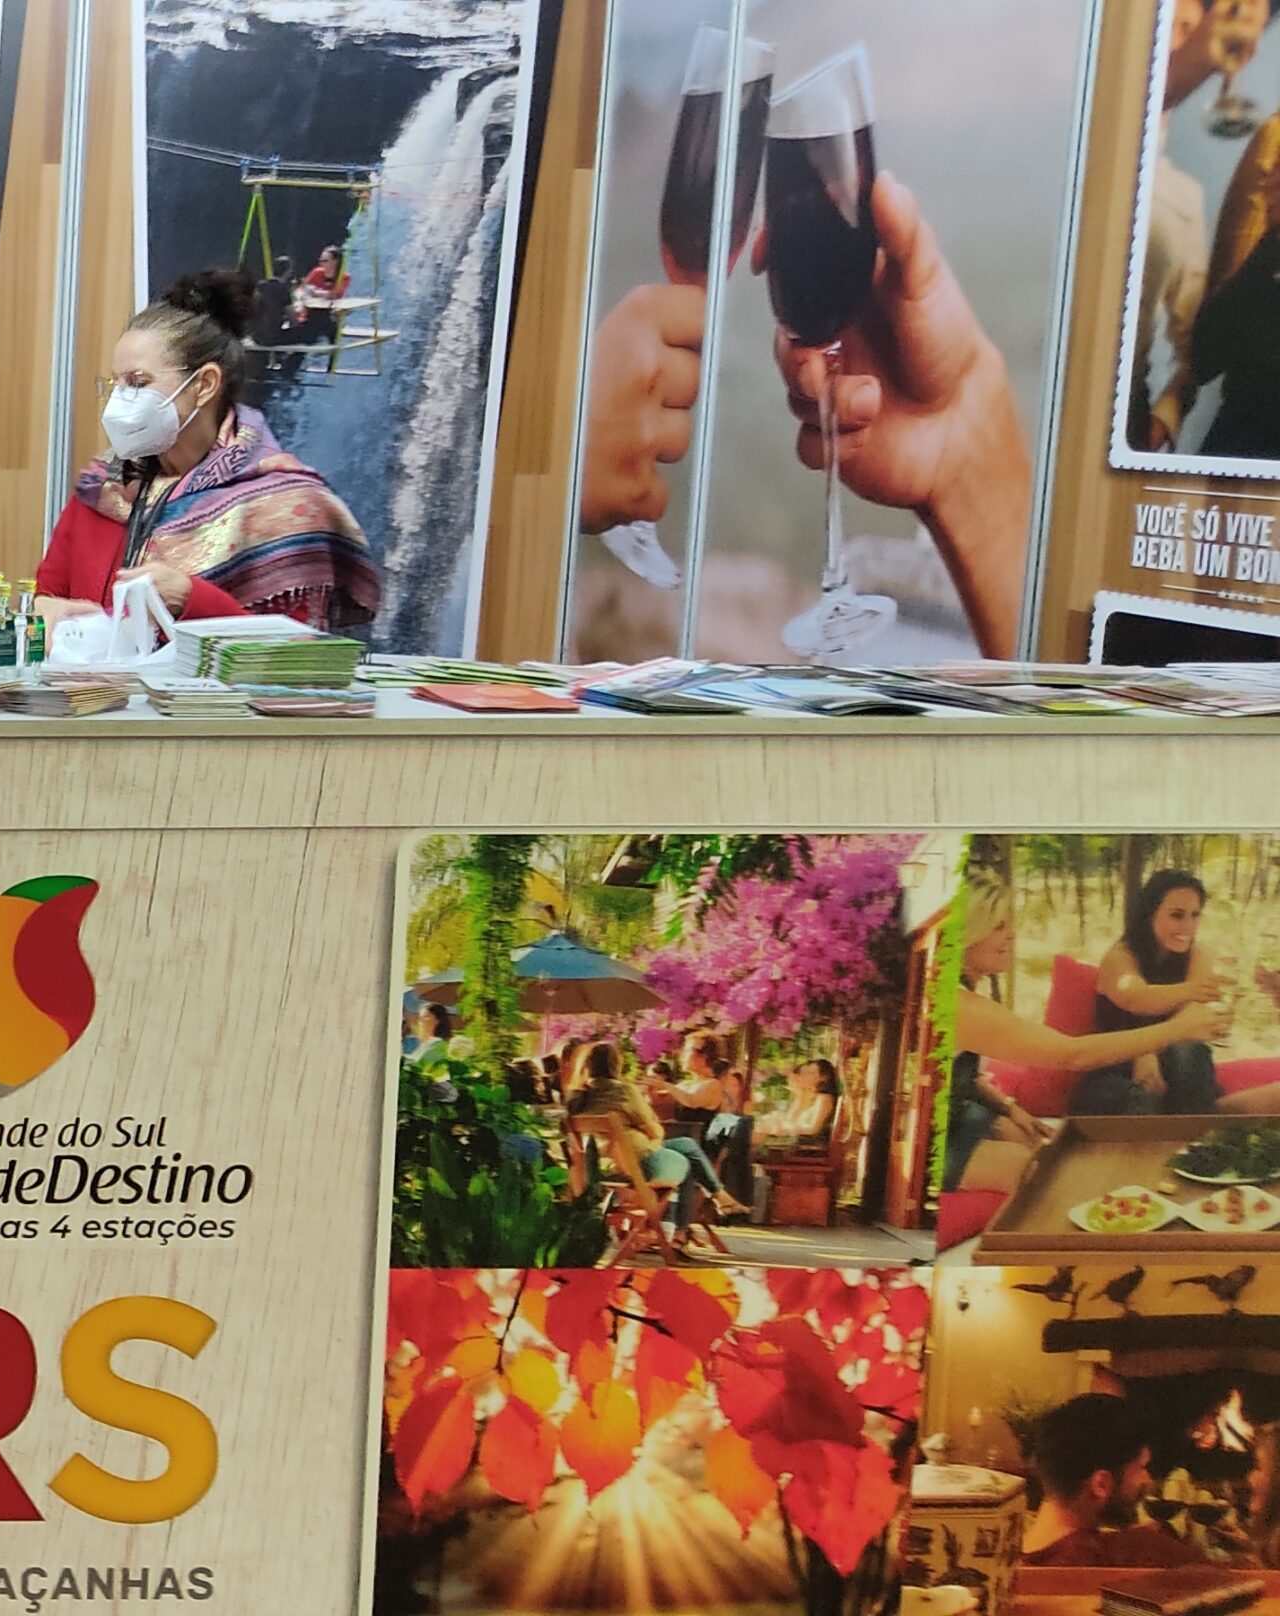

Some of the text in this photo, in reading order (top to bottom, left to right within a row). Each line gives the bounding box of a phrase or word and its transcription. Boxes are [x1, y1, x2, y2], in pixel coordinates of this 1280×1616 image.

[1136, 502, 1275, 546] VOCÊ SÓ VIVE
[1131, 537, 1185, 572] BEBA
[1194, 543, 1230, 577] UM
[57, 1116, 102, 1148] do
[111, 1116, 167, 1148] Sul
[49, 1214, 72, 1239] 4
[82, 1212, 236, 1246] estações
